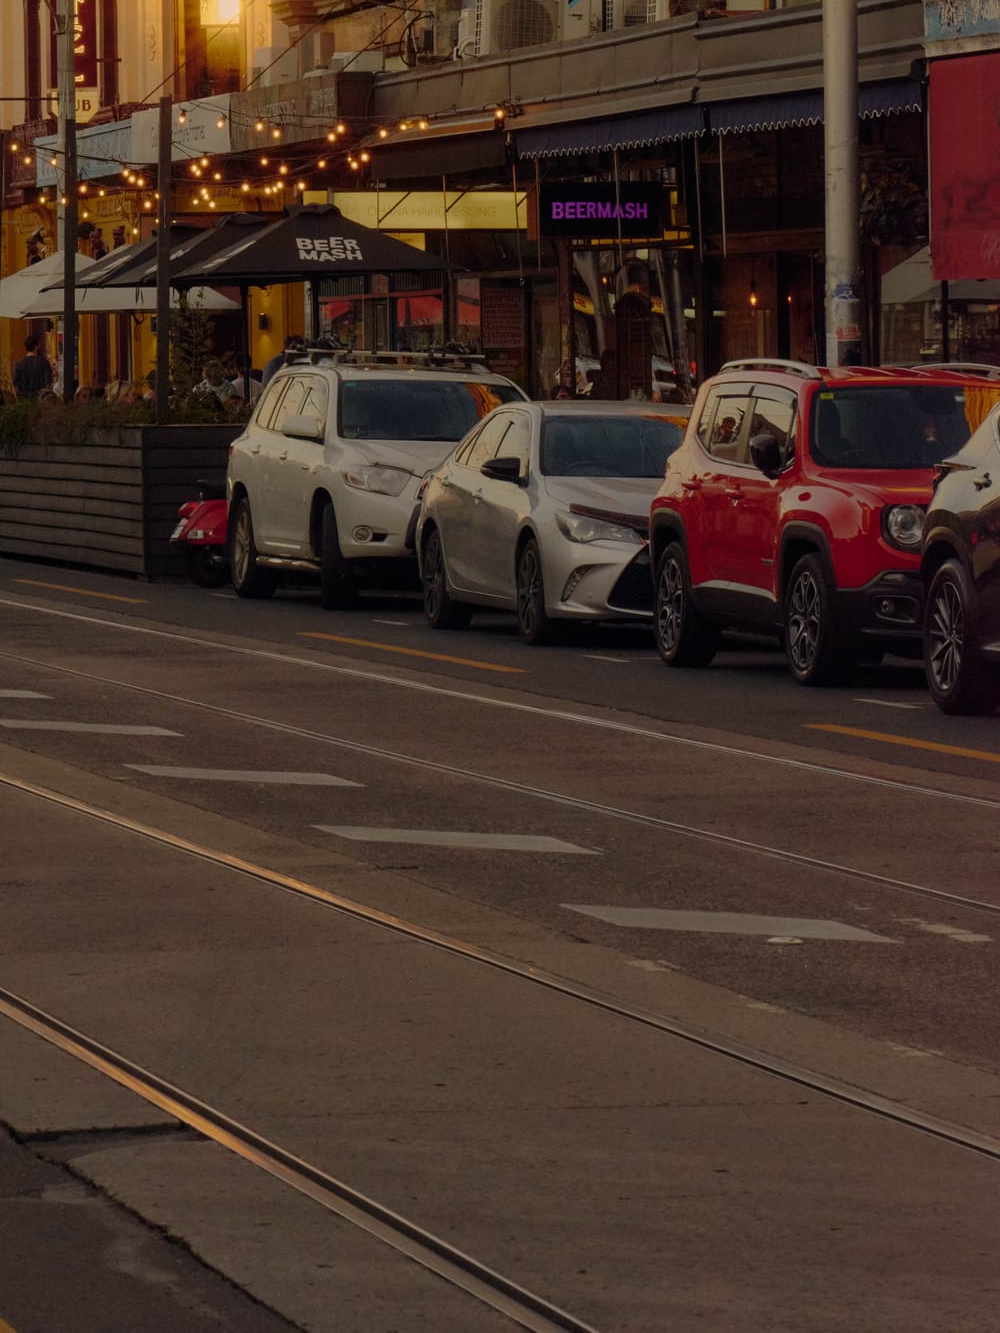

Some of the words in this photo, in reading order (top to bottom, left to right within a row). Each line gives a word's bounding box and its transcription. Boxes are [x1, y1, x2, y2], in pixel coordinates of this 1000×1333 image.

[552, 201, 648, 220] BEERMASH
[295, 236, 361, 251] BEER
[298, 248, 364, 262] MASH
